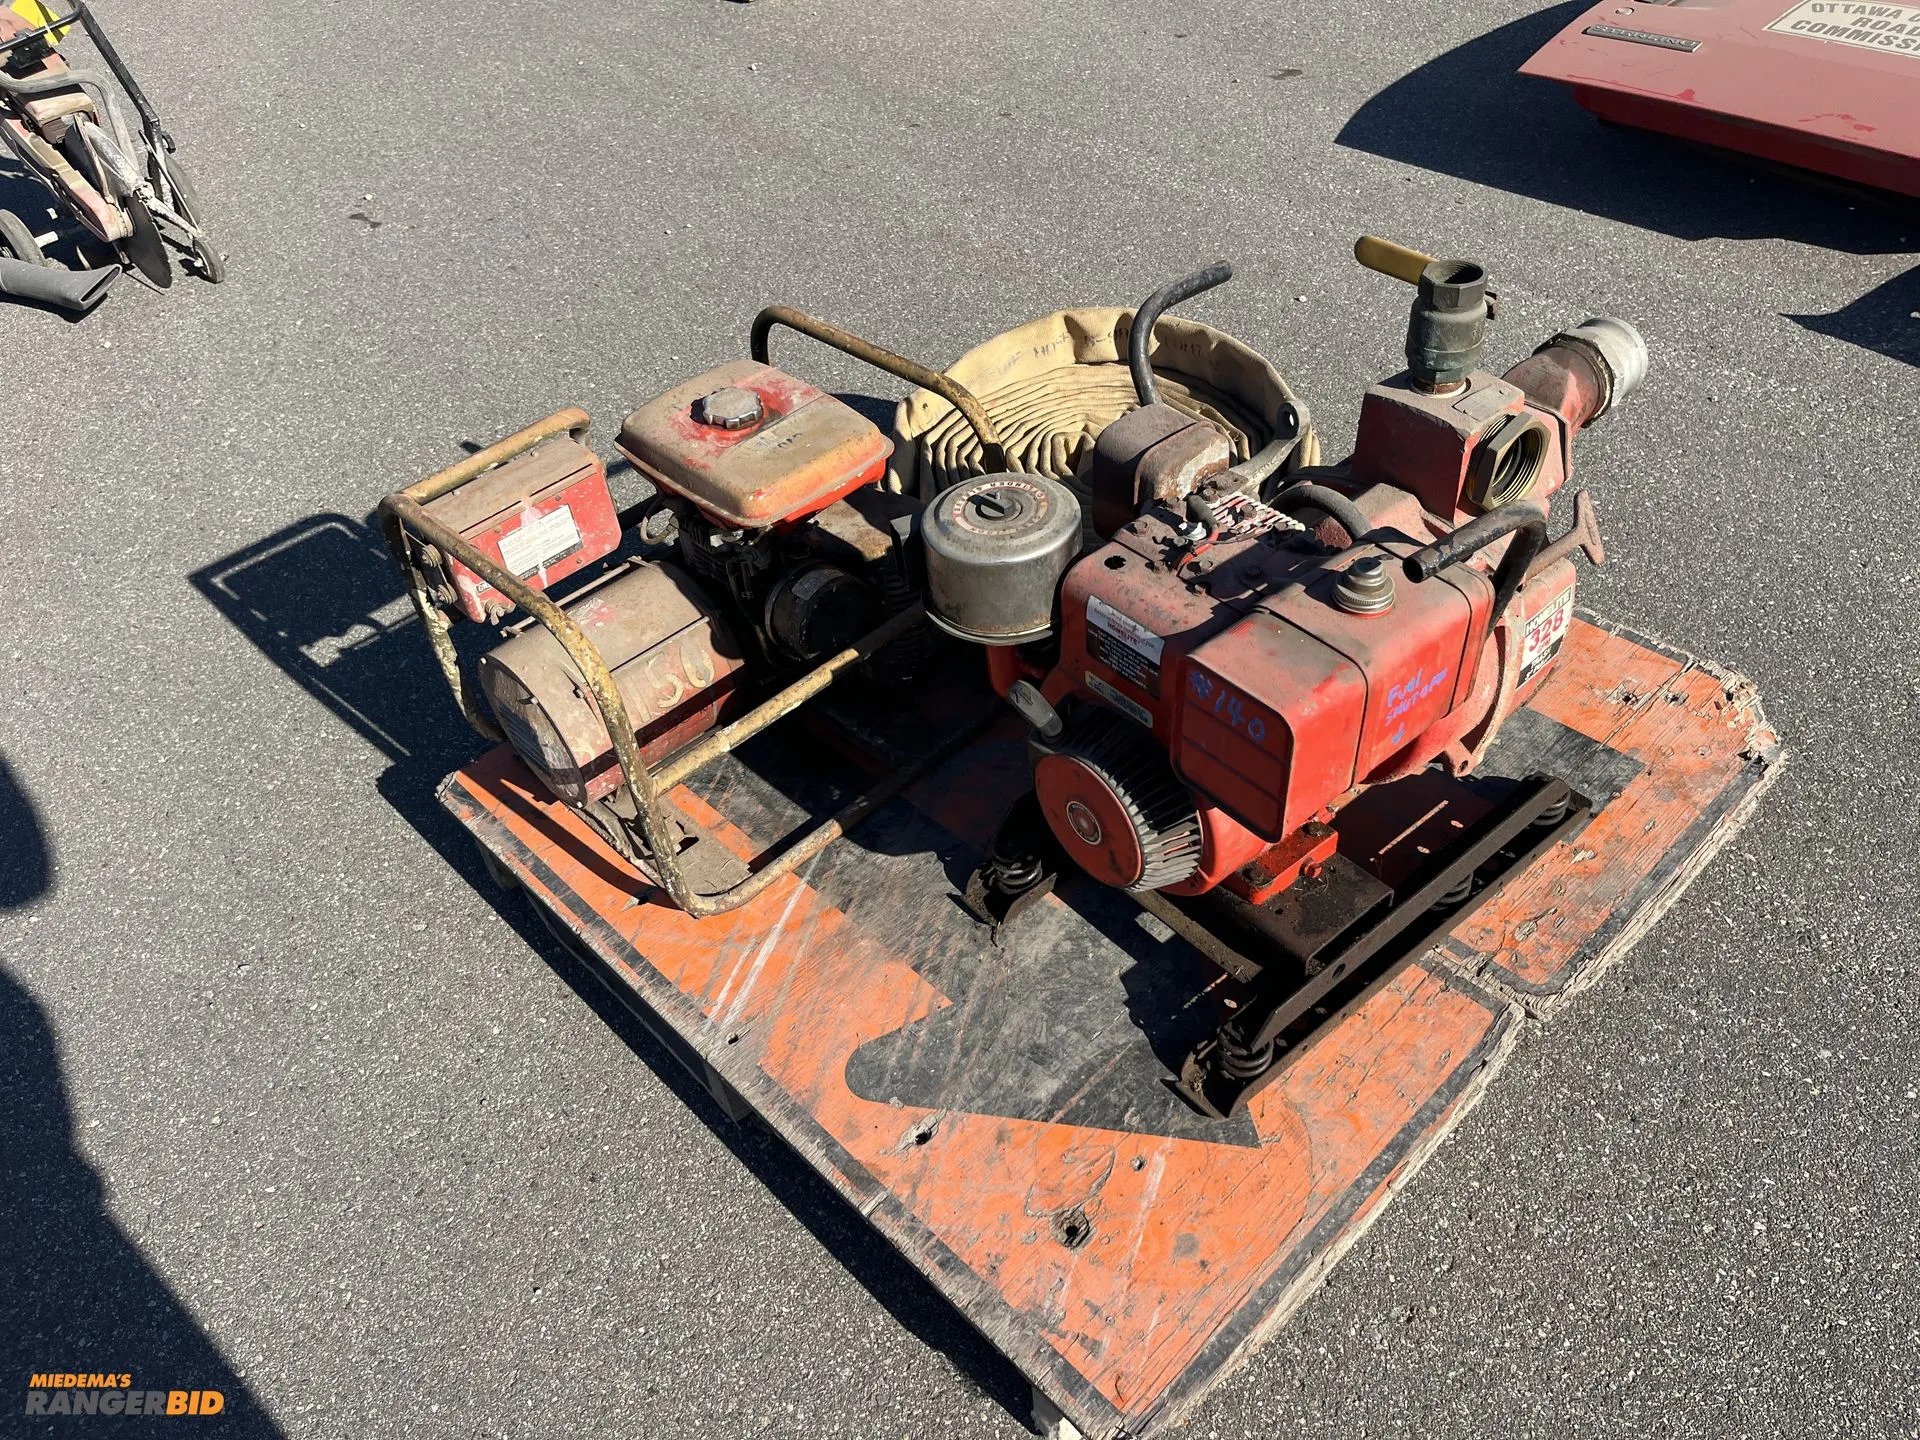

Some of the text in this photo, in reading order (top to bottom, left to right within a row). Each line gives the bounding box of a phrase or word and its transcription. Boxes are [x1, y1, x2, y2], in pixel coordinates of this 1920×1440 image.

[1811, 3, 1903, 19] OTTAWA
[1528, 608, 1564, 653] 328
[1388, 667, 1424, 708] Fuel
